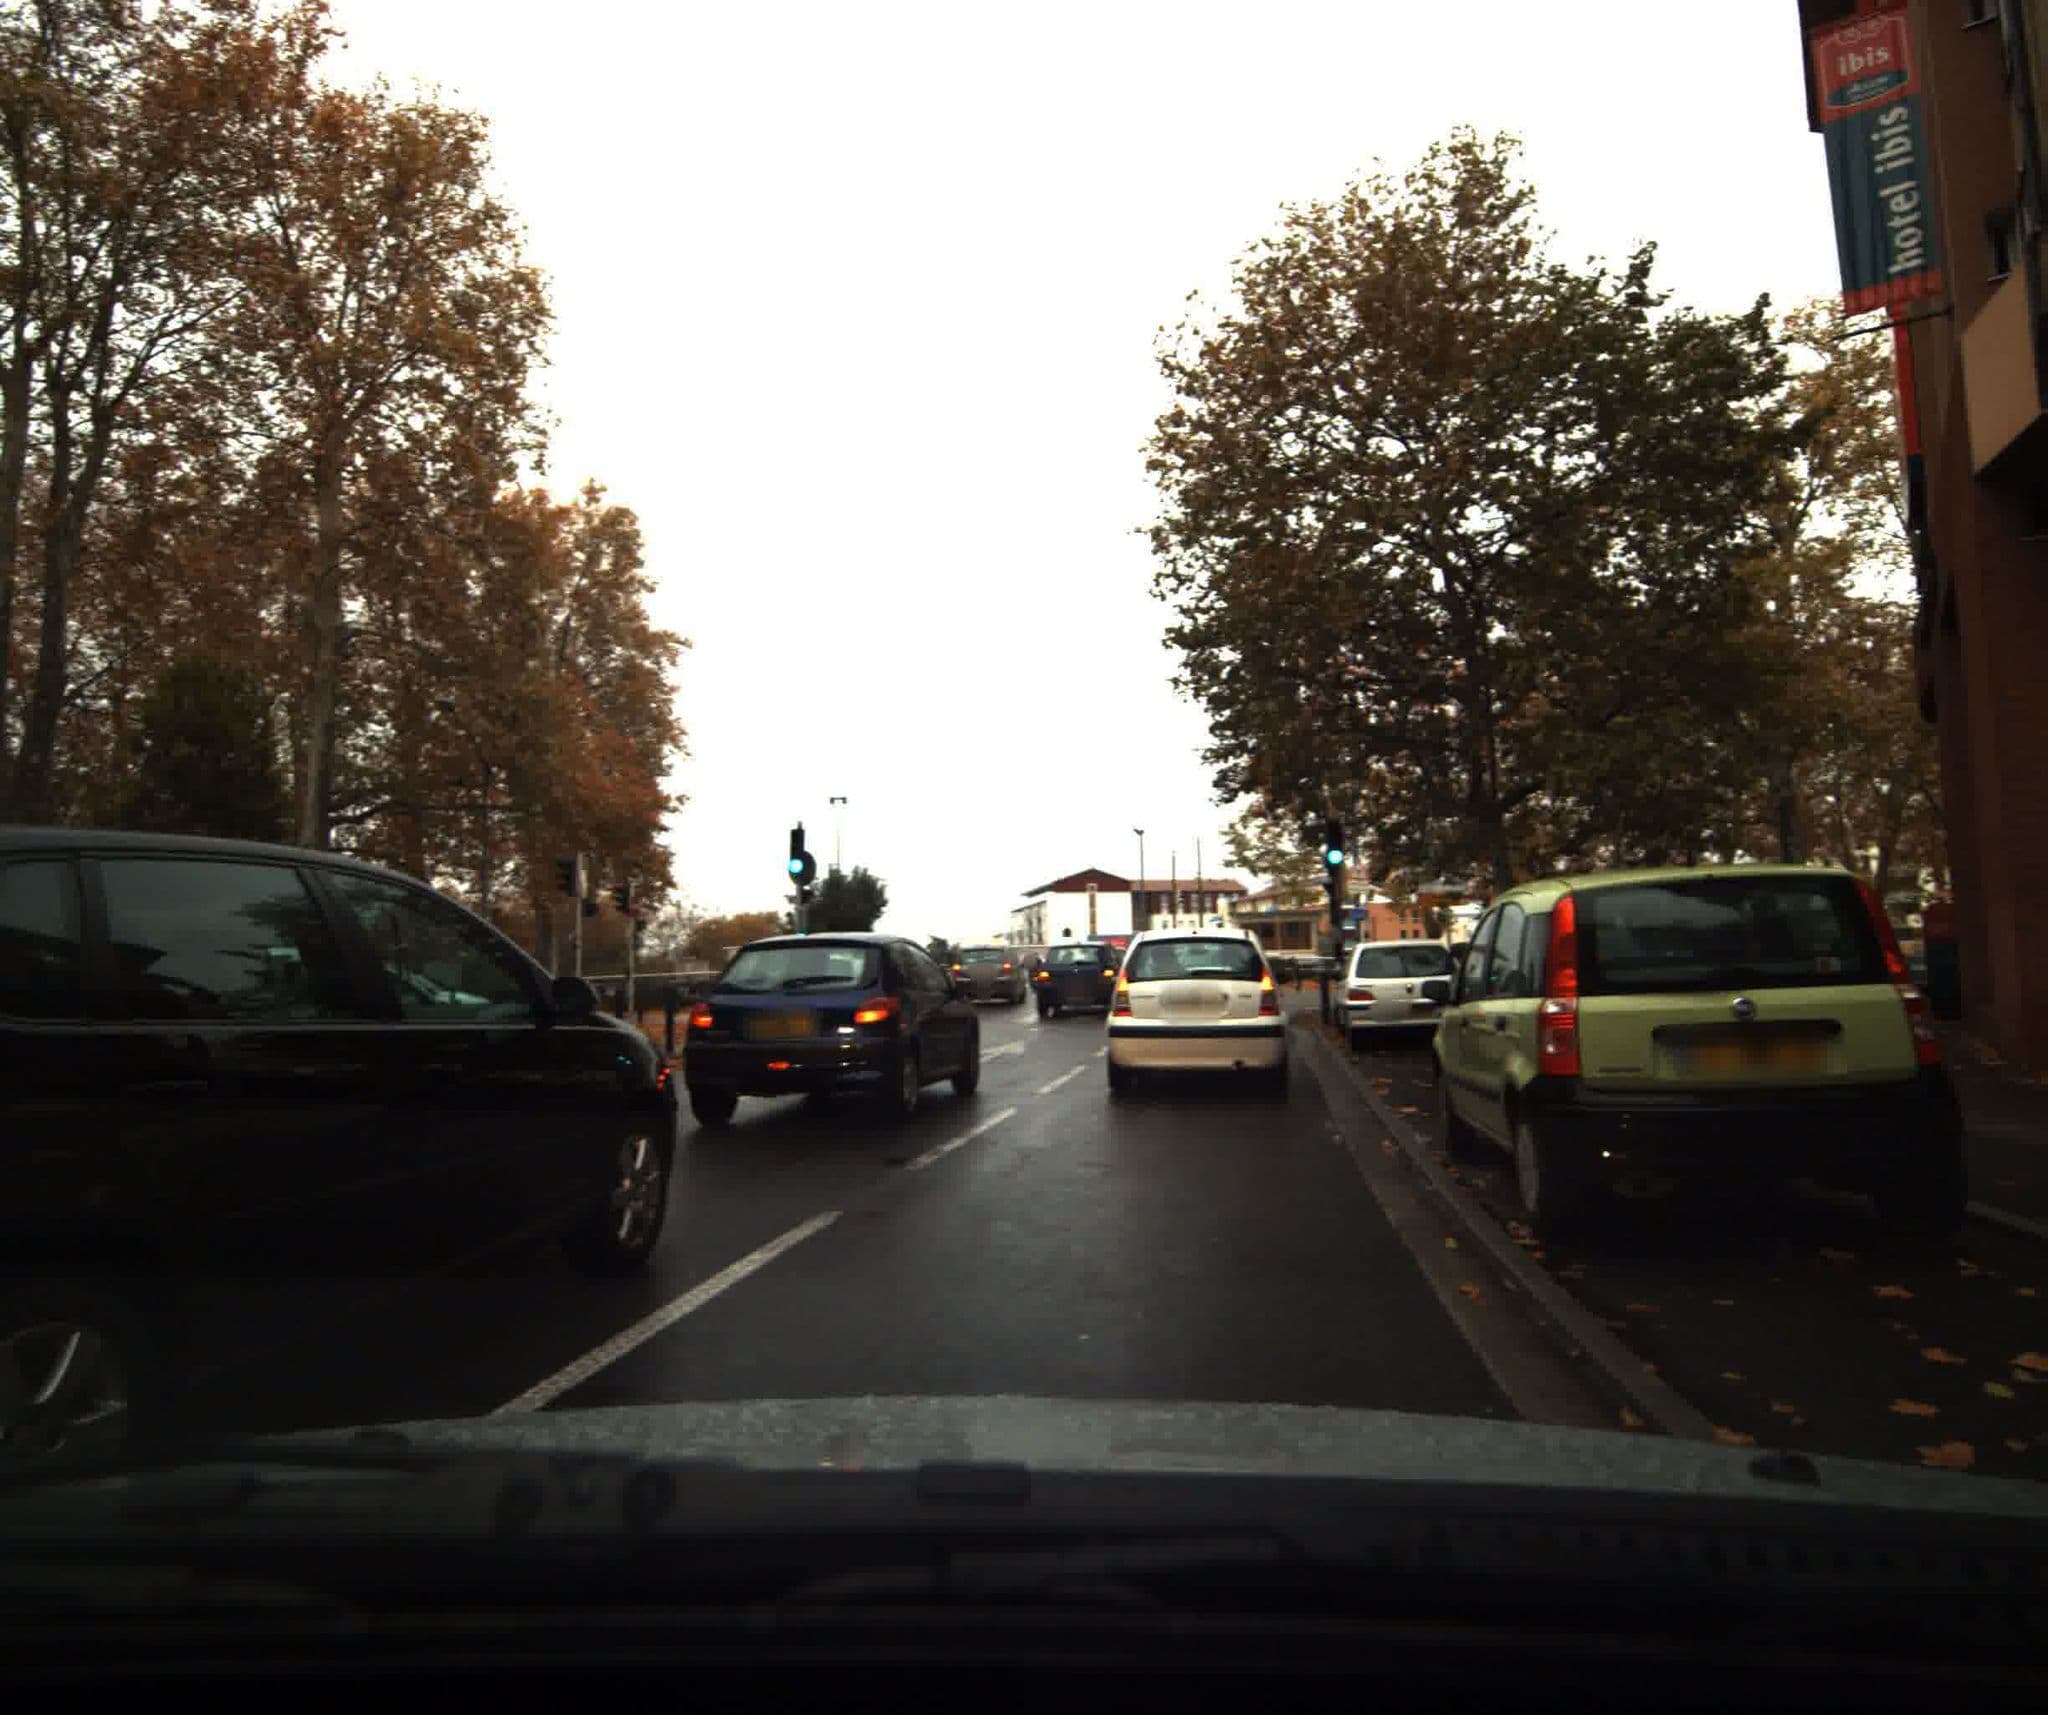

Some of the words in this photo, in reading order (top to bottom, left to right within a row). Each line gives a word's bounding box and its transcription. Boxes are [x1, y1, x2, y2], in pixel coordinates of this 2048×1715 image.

[1837, 46, 1890, 76] ibis
[1871, 106, 1915, 174] ibis
[1878, 180, 1923, 274] hotel
